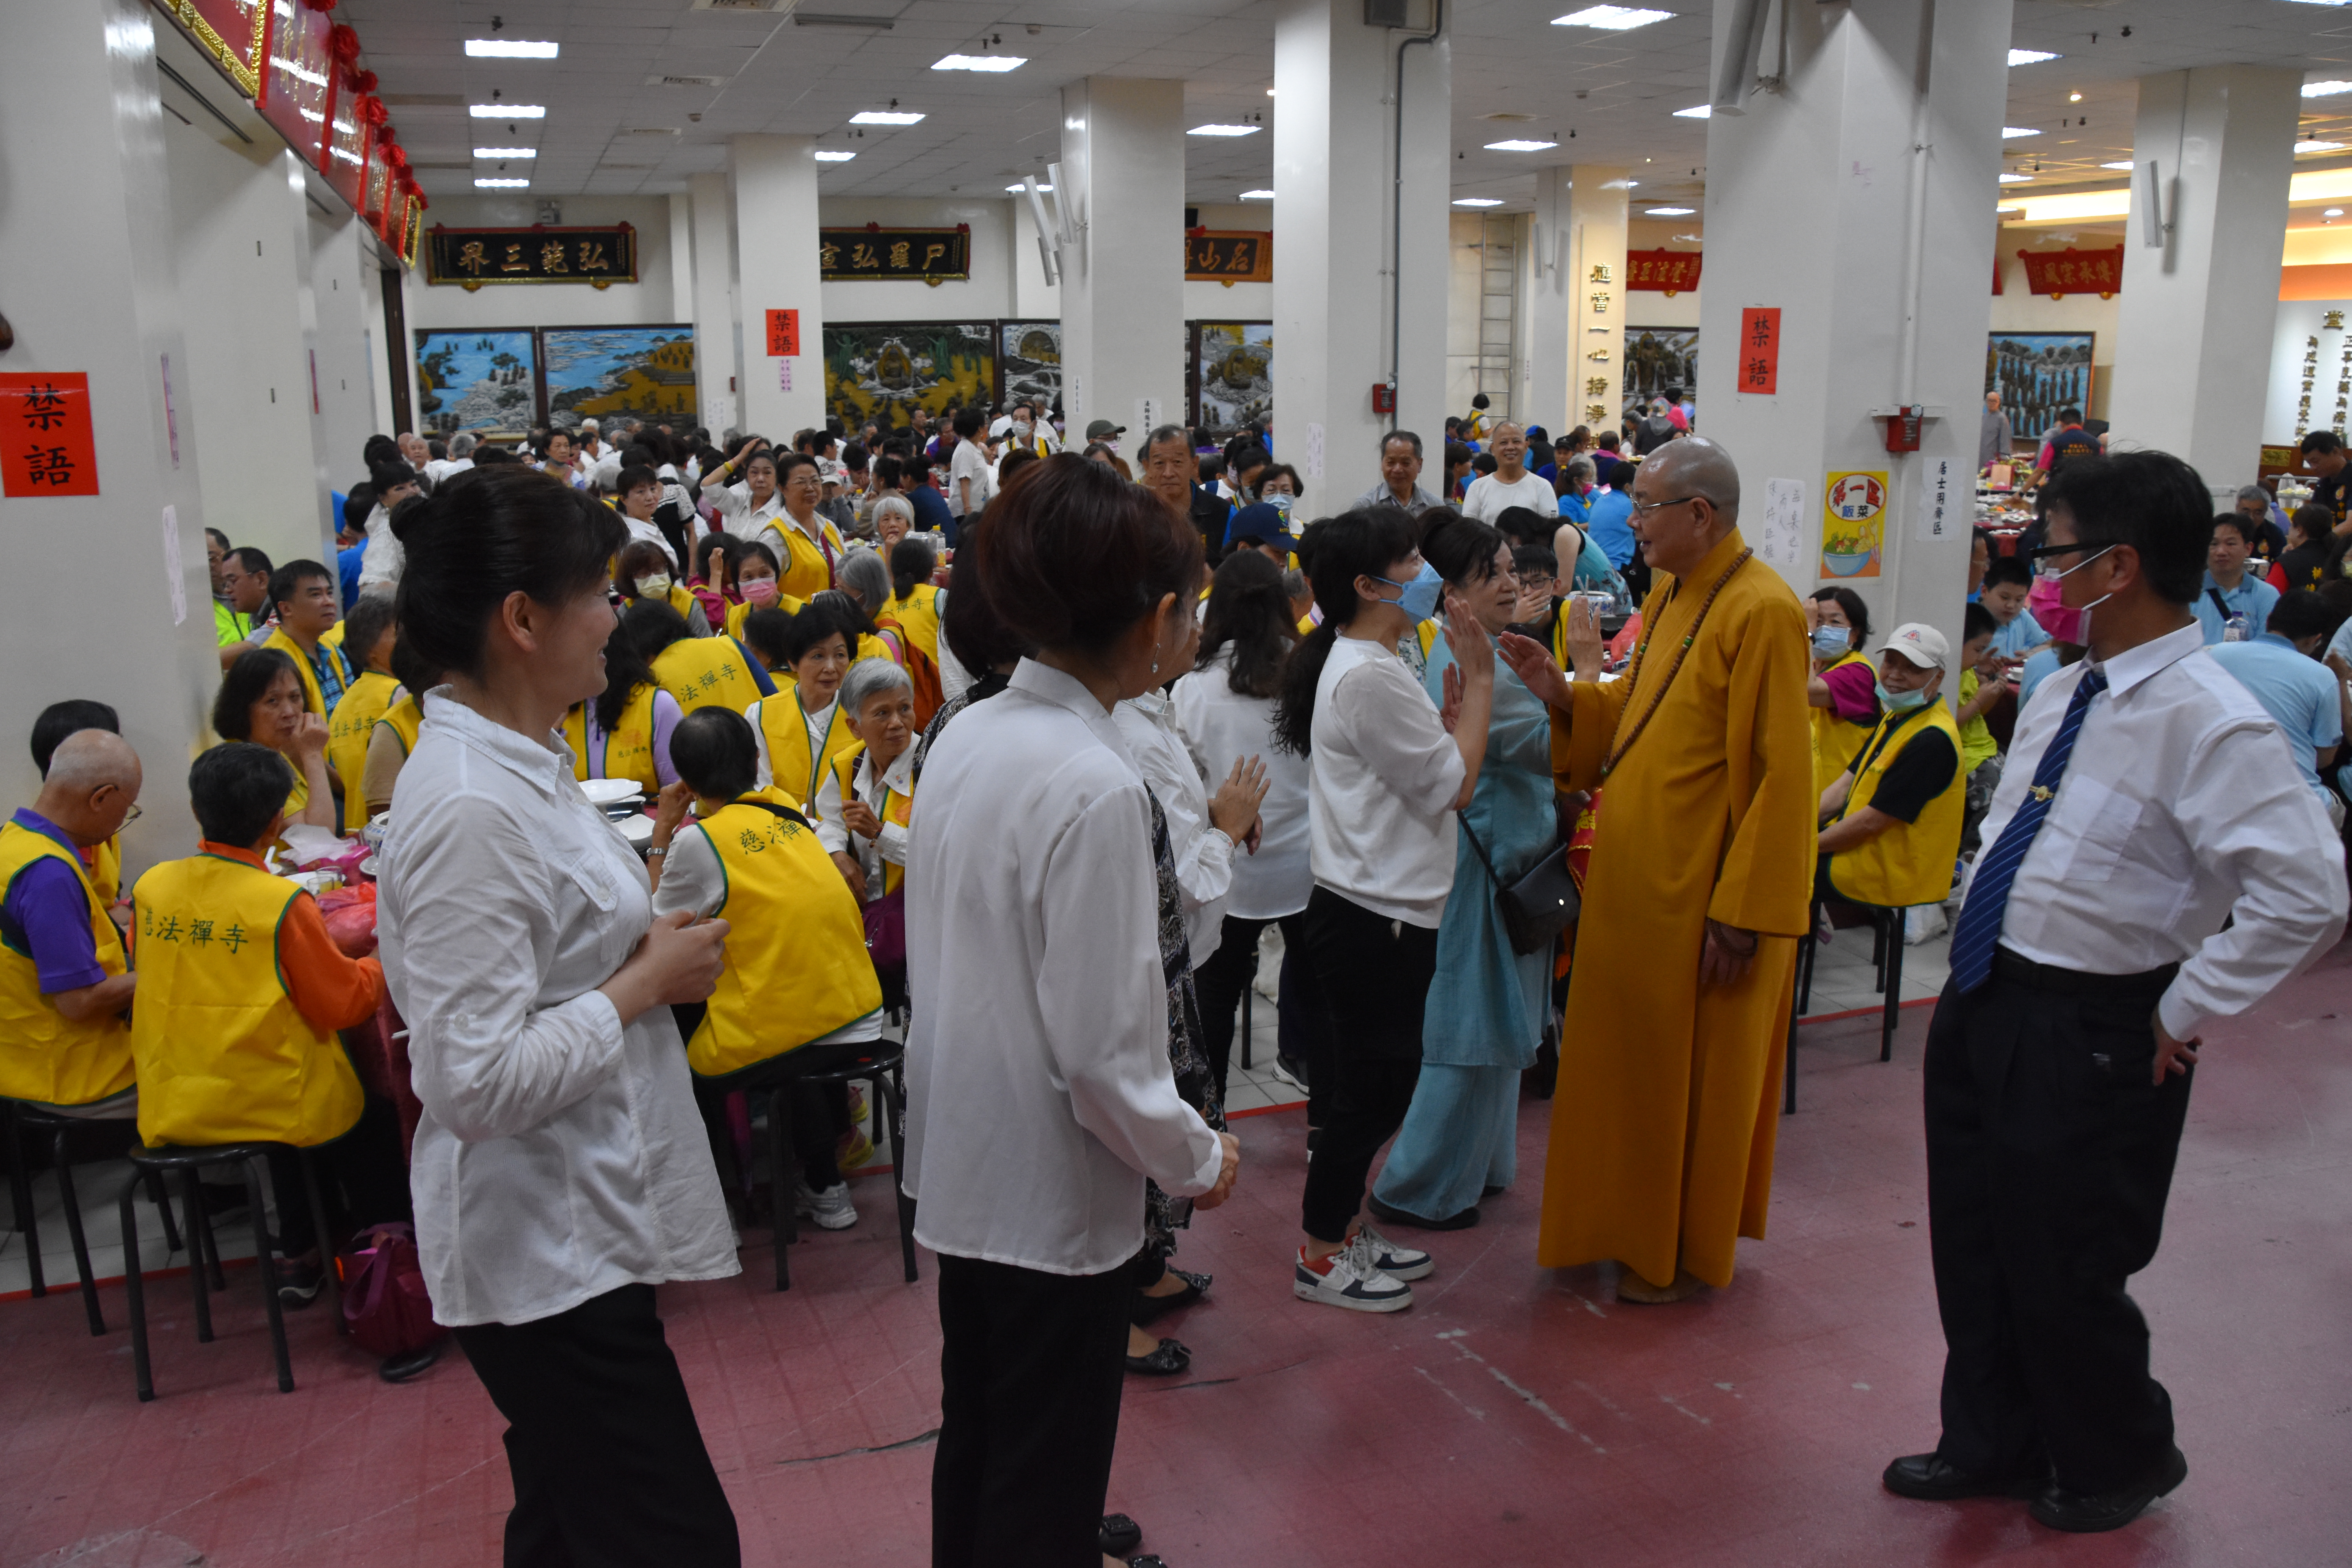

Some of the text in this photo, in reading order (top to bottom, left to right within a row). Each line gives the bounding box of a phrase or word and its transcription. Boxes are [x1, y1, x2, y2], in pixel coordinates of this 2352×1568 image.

[457, 240, 609, 274] 弘範三界
[773, 311, 793, 352] 禁語
[2323, 310, 2344, 331] 堂
[1748, 315, 1770, 386] 禁語
[23, 383, 75, 486] 禁語
[1831, 479, 1880, 508] 第一區
[1842, 505, 1869, 517] 飯菜
[890, 598, 924, 613] 禪寺
[676, 664, 736, 705] 法禪寺
